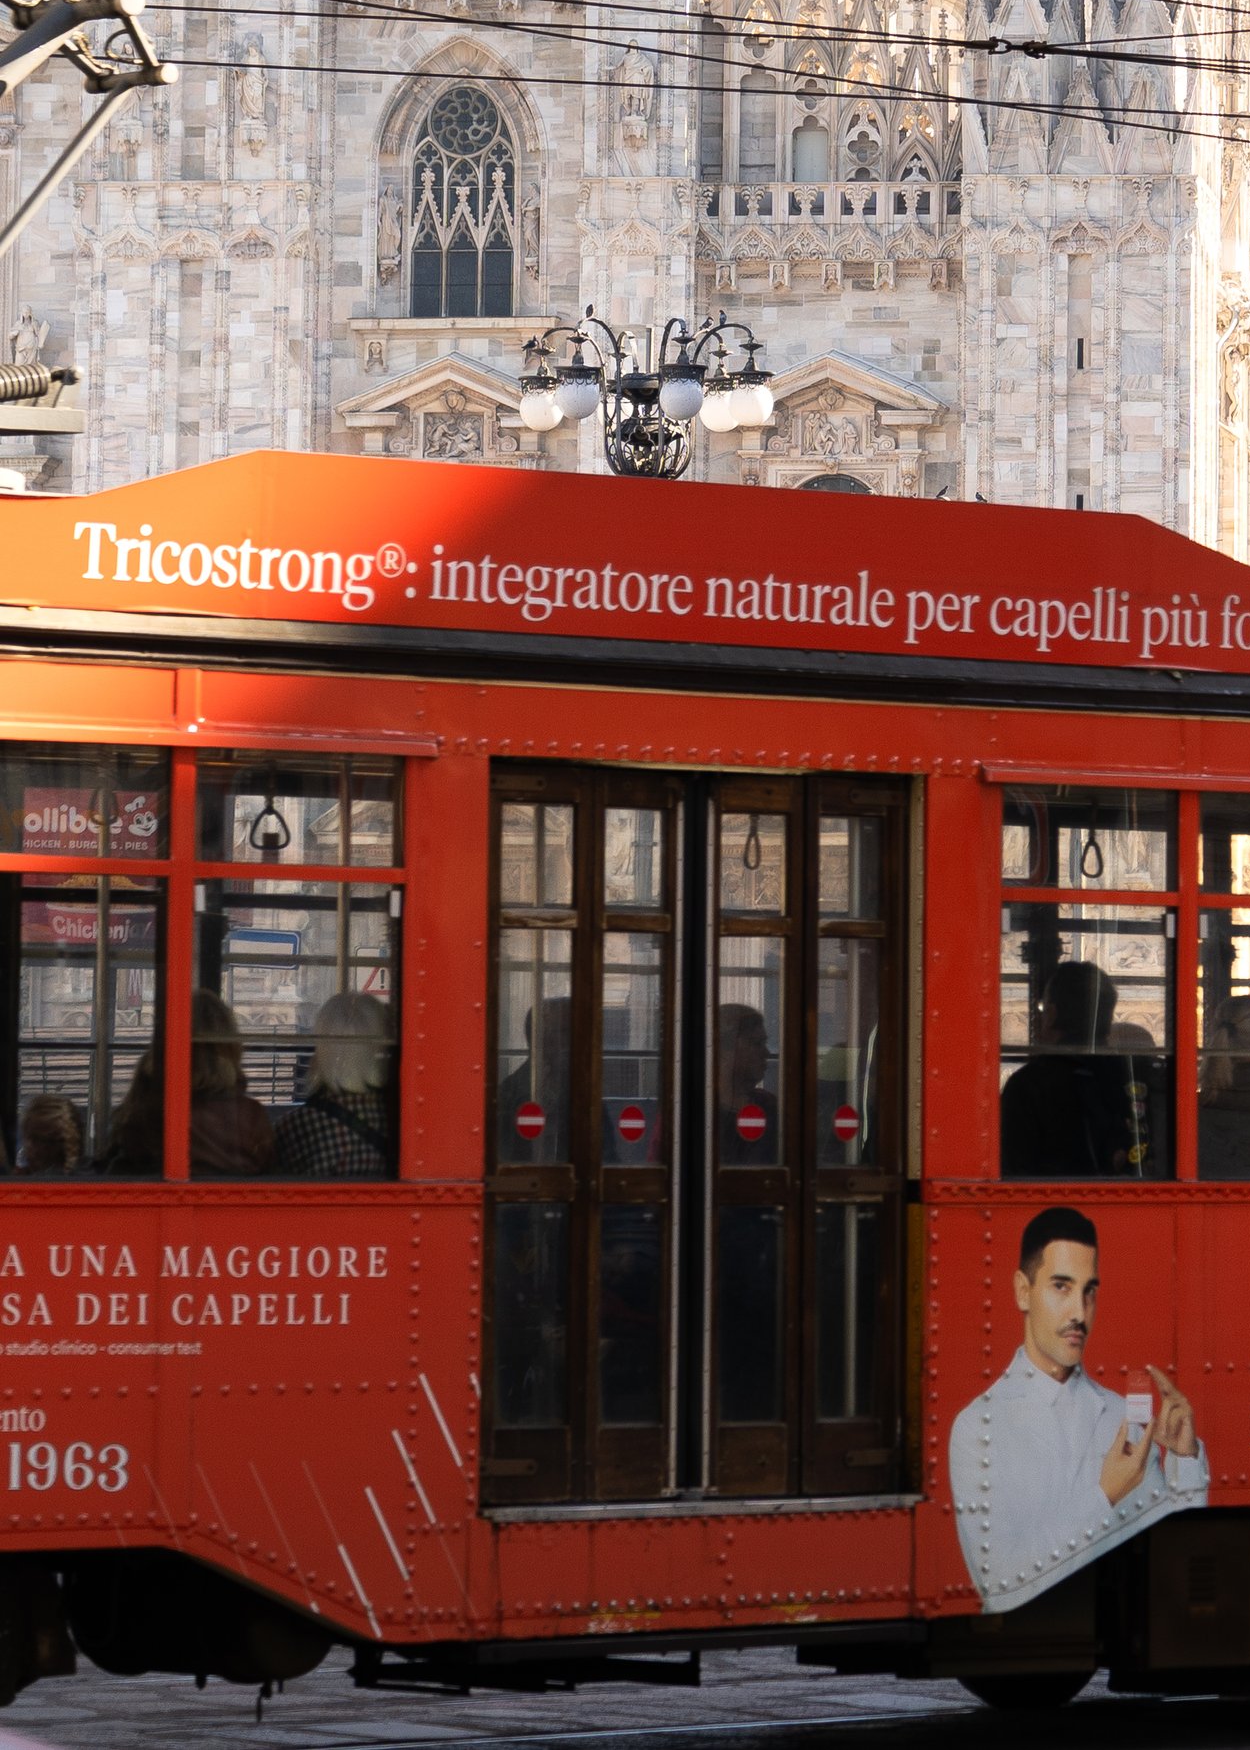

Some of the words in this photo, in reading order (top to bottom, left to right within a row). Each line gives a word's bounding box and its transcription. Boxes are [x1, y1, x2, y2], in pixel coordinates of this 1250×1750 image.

[74, 521, 418, 611] Tricostrong®:
[429, 544, 693, 621] integratore
[704, 571, 894, 627] naturale
[904, 591, 980, 644] per
[989, 587, 1129, 652] capelli
[1141, 594, 1210, 658] più
[24, 804, 123, 834] ollibee
[69, 840, 117, 850] BURGS
[125, 841, 148, 850] PIES
[48, 1244, 138, 1277] UNA
[161, 1245, 389, 1278] MAGGIORE
[75, 1293, 149, 1325] DEI
[171, 1293, 350, 1326] CAPELLI
[0, 1406, 46, 1432] nto
[8, 1440, 130, 1493] 1963
